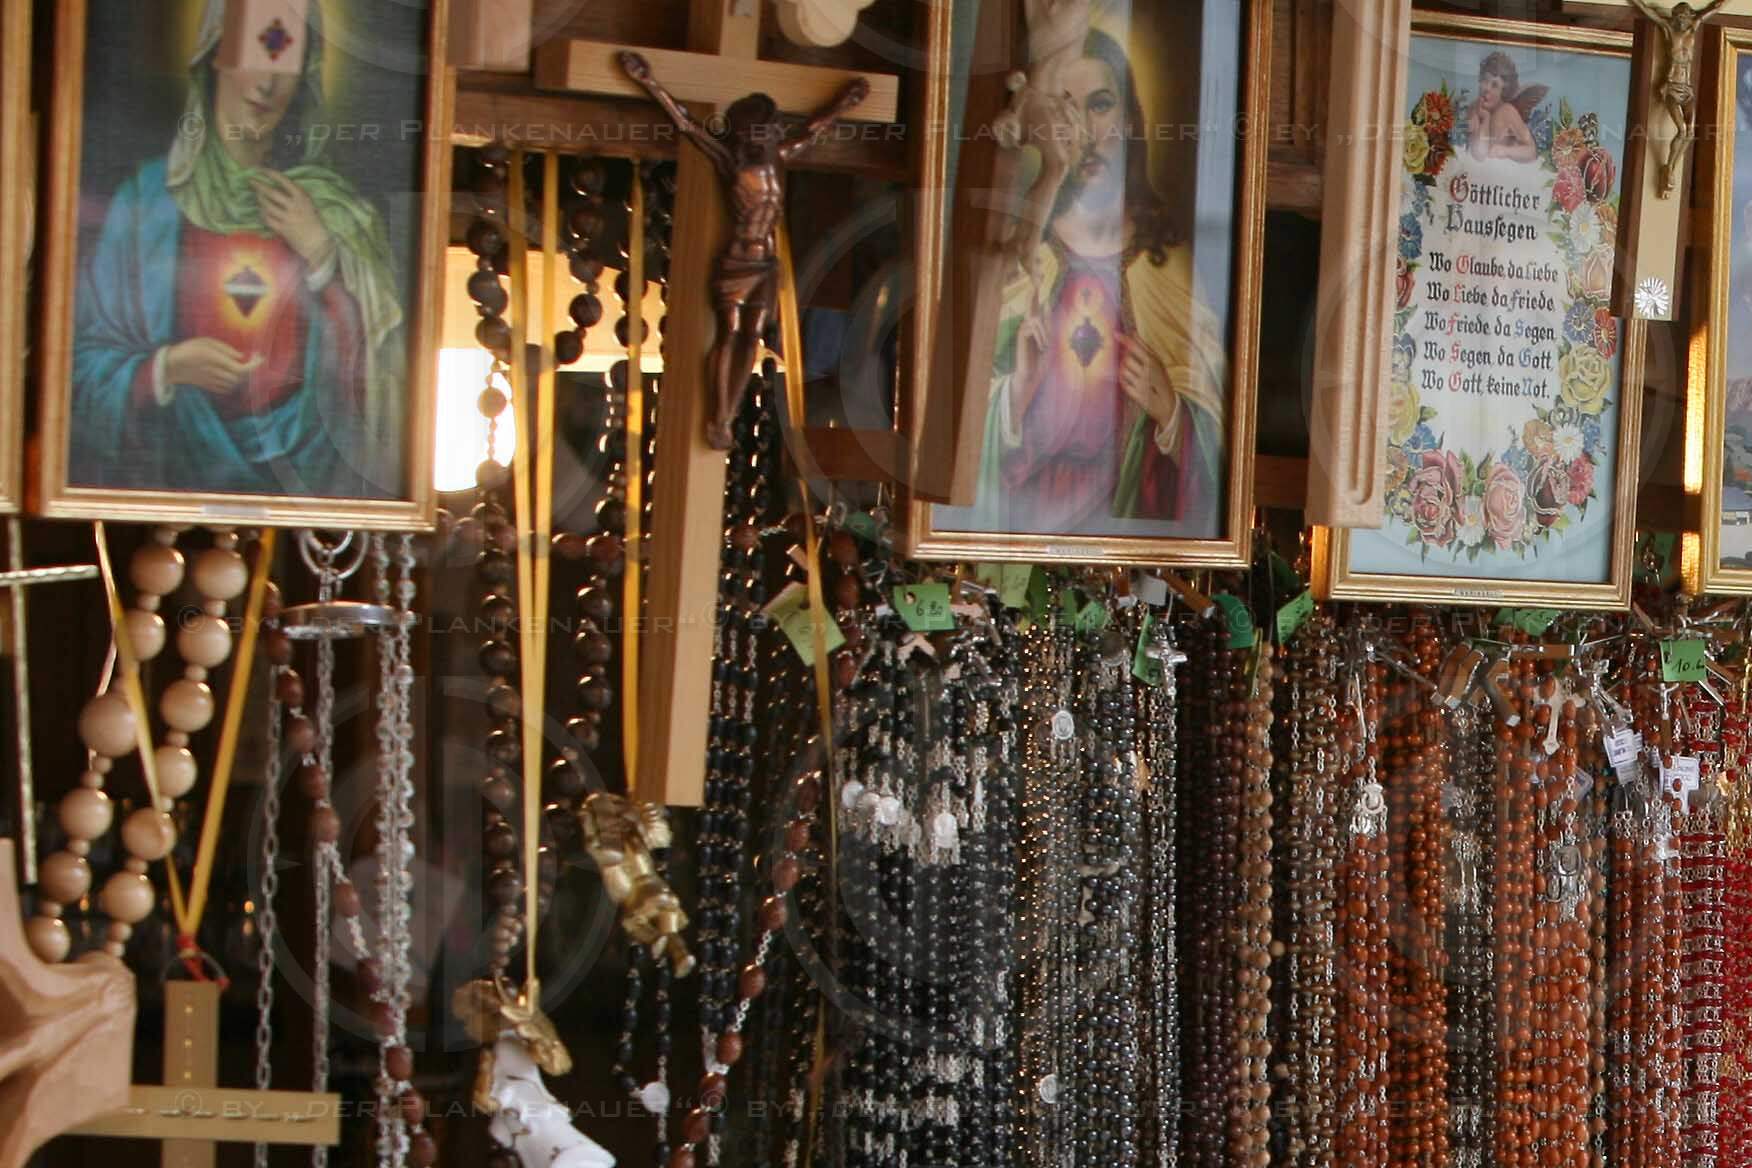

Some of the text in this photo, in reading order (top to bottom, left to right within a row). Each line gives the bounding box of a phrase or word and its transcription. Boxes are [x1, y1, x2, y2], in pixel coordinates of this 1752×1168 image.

[1450, 173, 1540, 215] Göttlicher
[1429, 251, 1452, 273] Wo
[1507, 260, 1524, 280] da
[1426, 281, 1450, 302] Wo
[1491, 286, 1508, 307] da
[1424, 311, 1446, 331] Wo
[1494, 315, 1511, 337] da
[1424, 341, 1446, 361] Wo
[1497, 345, 1514, 367] da
[1422, 369, 1444, 390] Wo
[1486, 375, 1520, 397] keine
[1521, 377, 1550, 399] Not.
